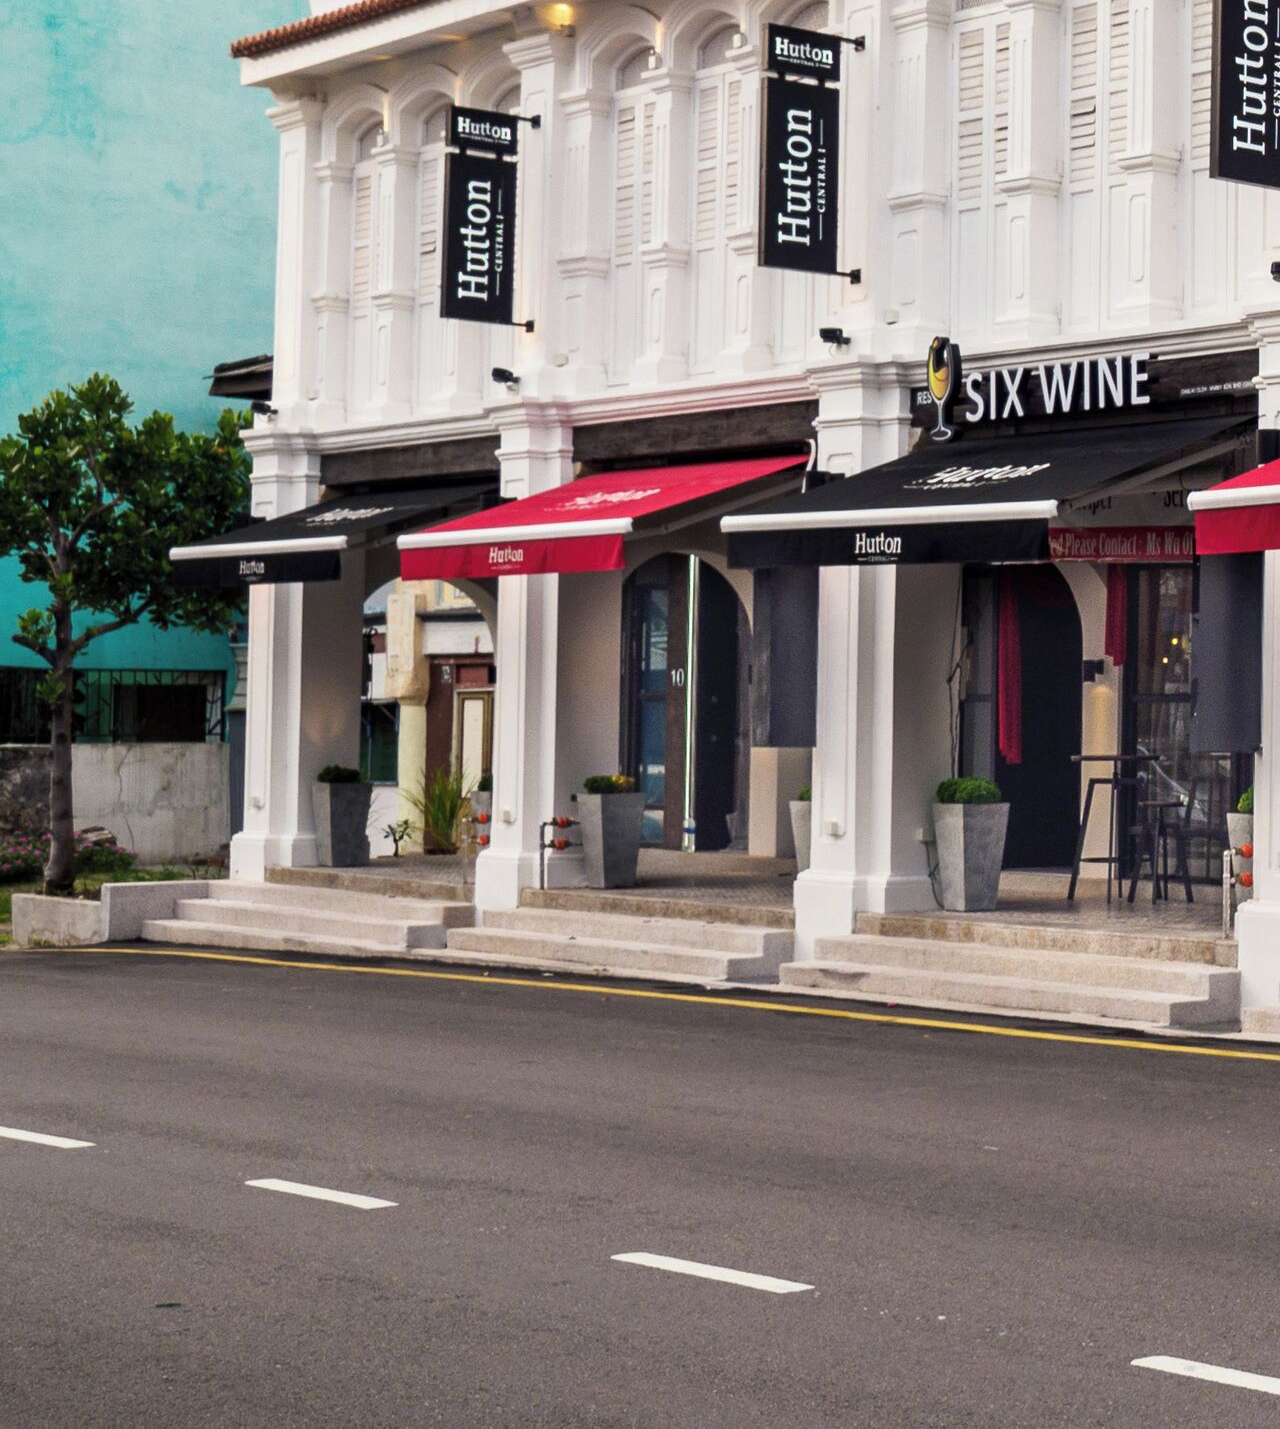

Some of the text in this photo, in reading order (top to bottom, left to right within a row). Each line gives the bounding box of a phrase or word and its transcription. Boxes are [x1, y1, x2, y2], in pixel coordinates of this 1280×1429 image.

[775, 37, 833, 64] Hutton
[457, 116, 512, 140] Hutton
[778, 109, 812, 246] Hutton
[817, 157, 826, 213] CENTRAL
[457, 180, 491, 301] Hutton
[916, 390, 932, 405] RES
[965, 353, 1150, 422] SIX WINE
[488, 545, 524, 563] Hutton
[855, 532, 902, 554] Hutton
[1065, 533, 1096, 556] Please
[1146, 532, 1160, 556] Ms
[671, 668, 684, 687] 10
